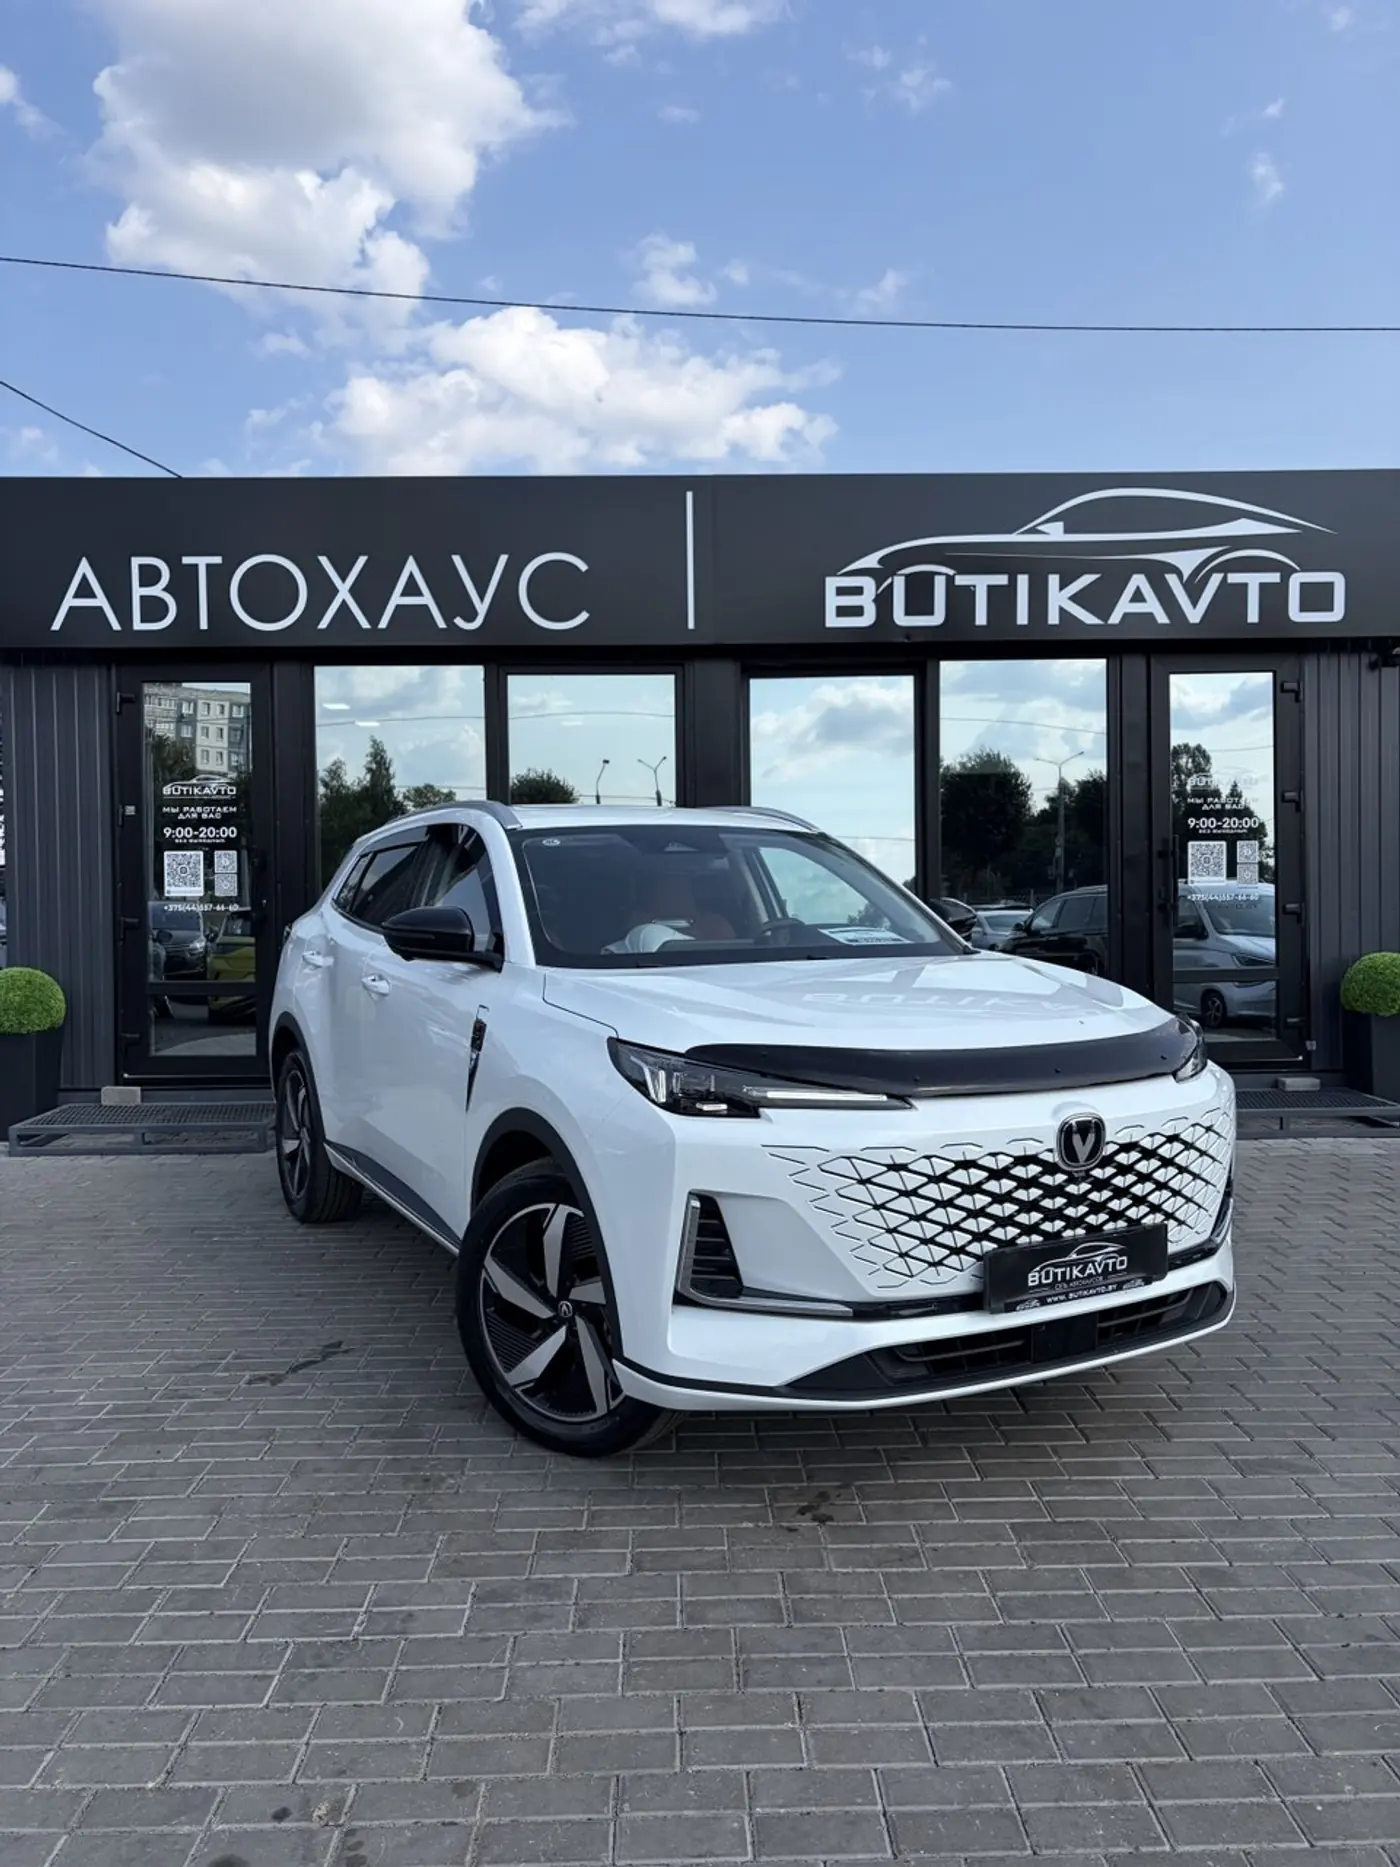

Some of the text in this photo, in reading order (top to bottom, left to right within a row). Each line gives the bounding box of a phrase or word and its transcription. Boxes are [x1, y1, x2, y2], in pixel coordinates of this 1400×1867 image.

[50, 551, 590, 632] АВТОХАУС
[824, 570, 1347, 629] BUTIKAVTO
[162, 786, 237, 795] BUTIKAVTO
[1201, 803, 1221, 811] ДЛЯ
[1187, 817, 1260, 829] 9:00-20:00
[163, 826, 238, 839] 9:00-20:00
[1027, 1256, 1128, 1287] BUTIKAVTO
